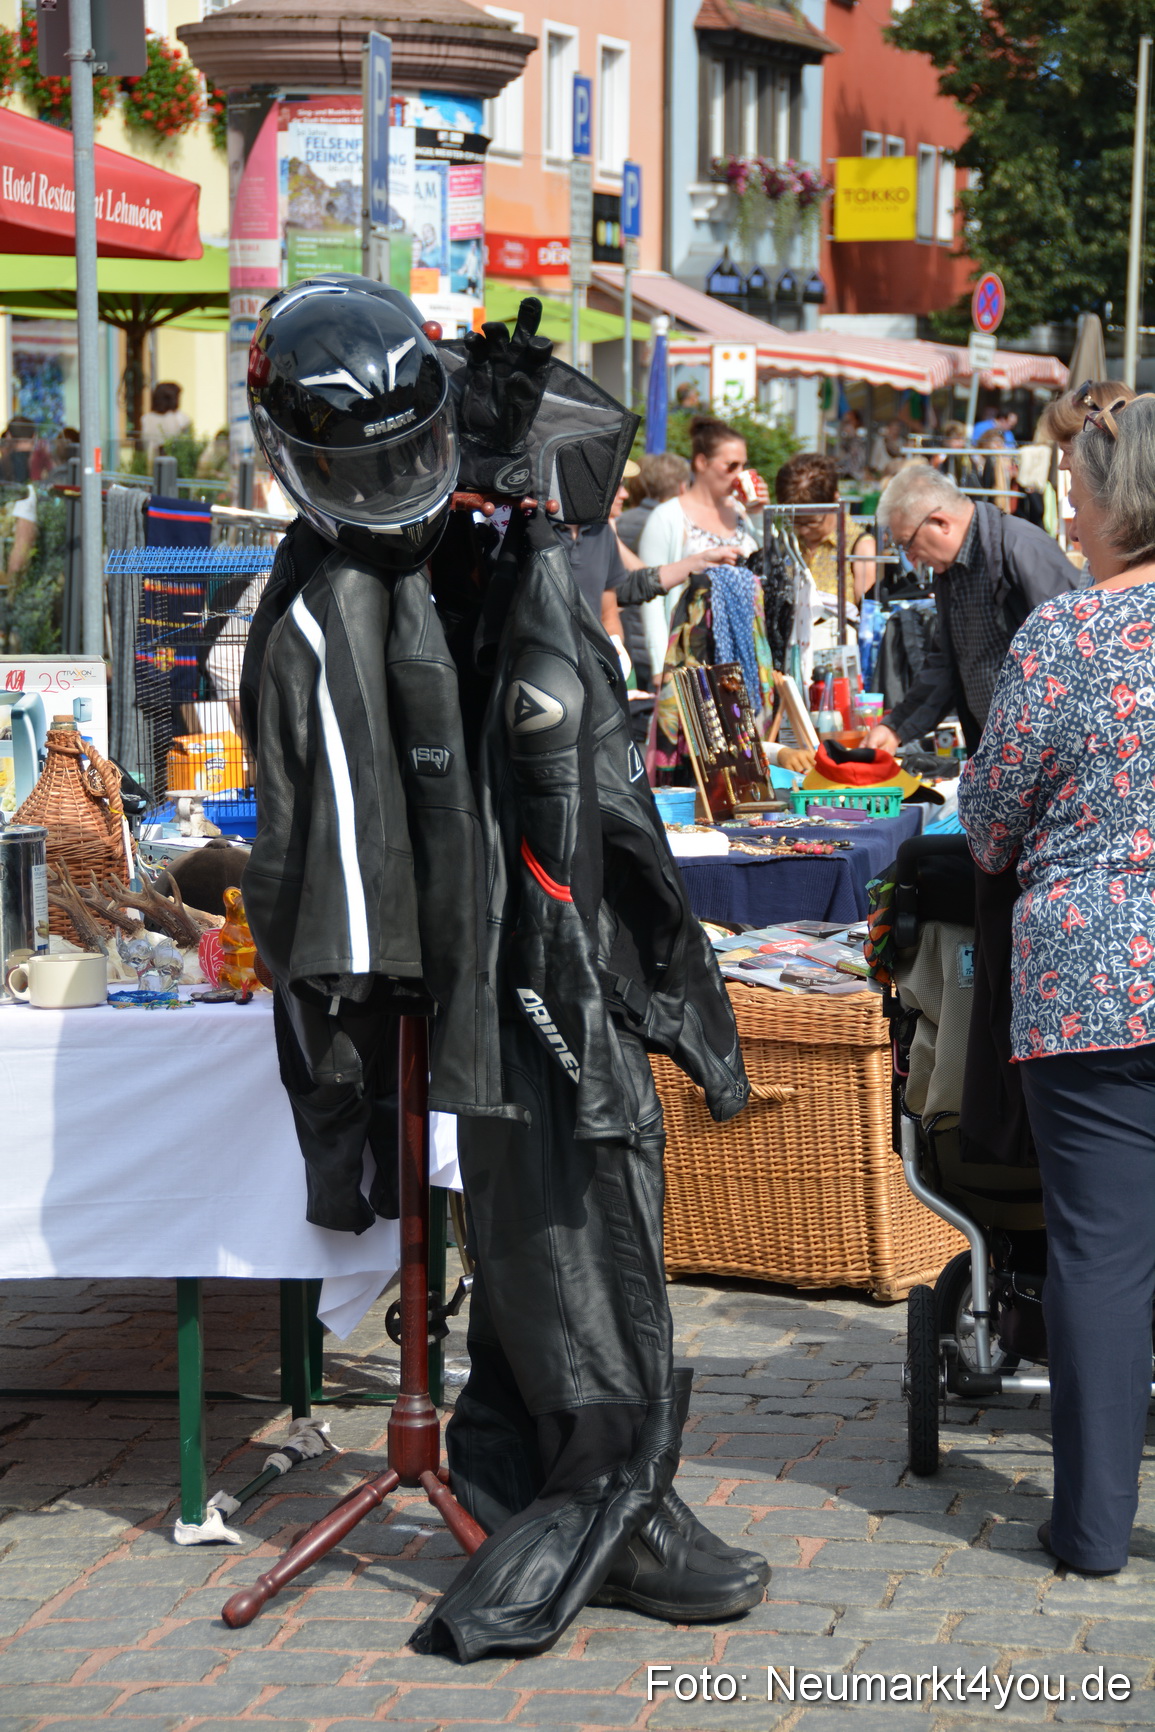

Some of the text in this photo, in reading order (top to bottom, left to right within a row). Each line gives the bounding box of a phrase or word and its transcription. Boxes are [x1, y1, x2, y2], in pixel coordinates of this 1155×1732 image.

[305, 136, 364, 150] FELSENF
[575, 85, 589, 147] P
[2, 165, 36, 206] Hotel
[105, 188, 163, 232] Lehmeier
[626, 171, 639, 229] P
[363, 408, 417, 438] SHARK
